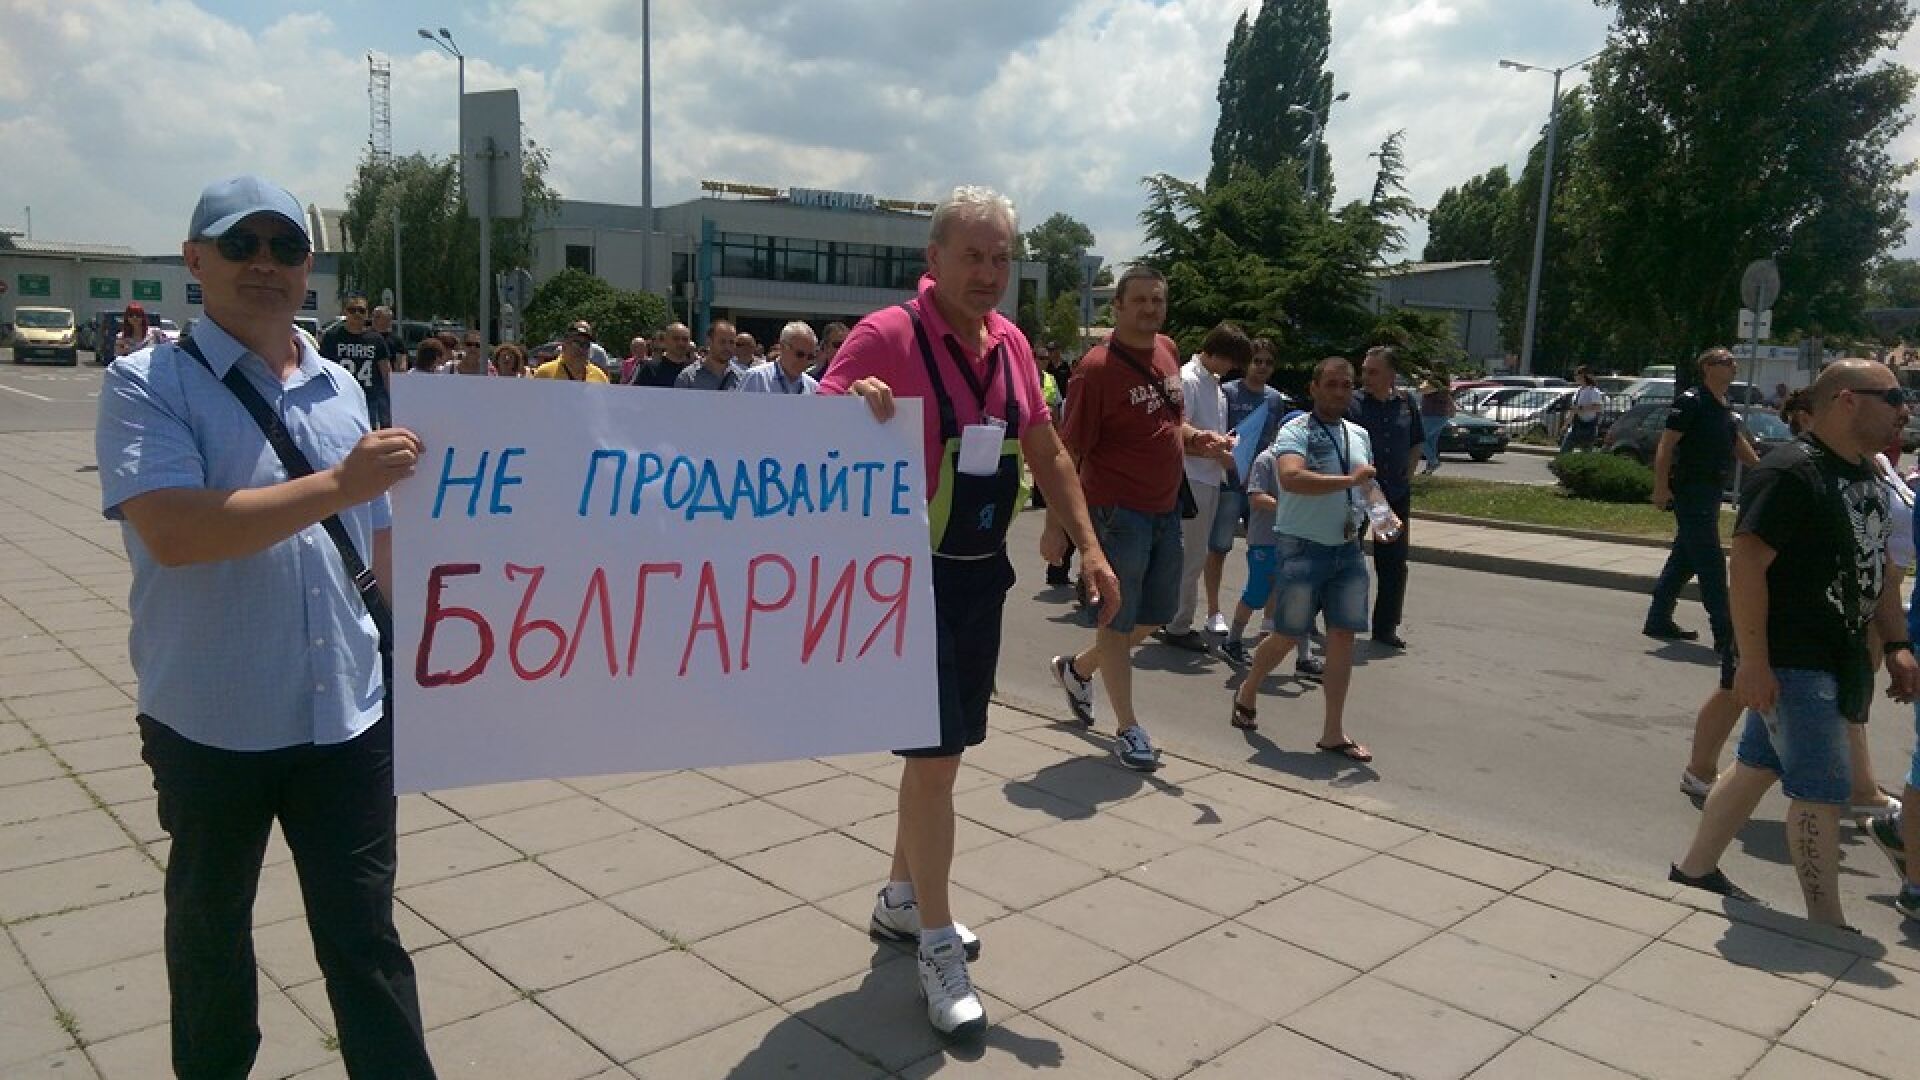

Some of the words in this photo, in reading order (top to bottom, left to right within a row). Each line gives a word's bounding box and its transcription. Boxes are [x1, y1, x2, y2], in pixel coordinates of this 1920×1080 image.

[338, 343, 376, 360] PARIS
[432, 447, 527, 519] НЕ
[577, 449, 912, 521] ПРОДАВАЙТЕ
[415, 553, 912, 688] БЪЛГАРИЯ
